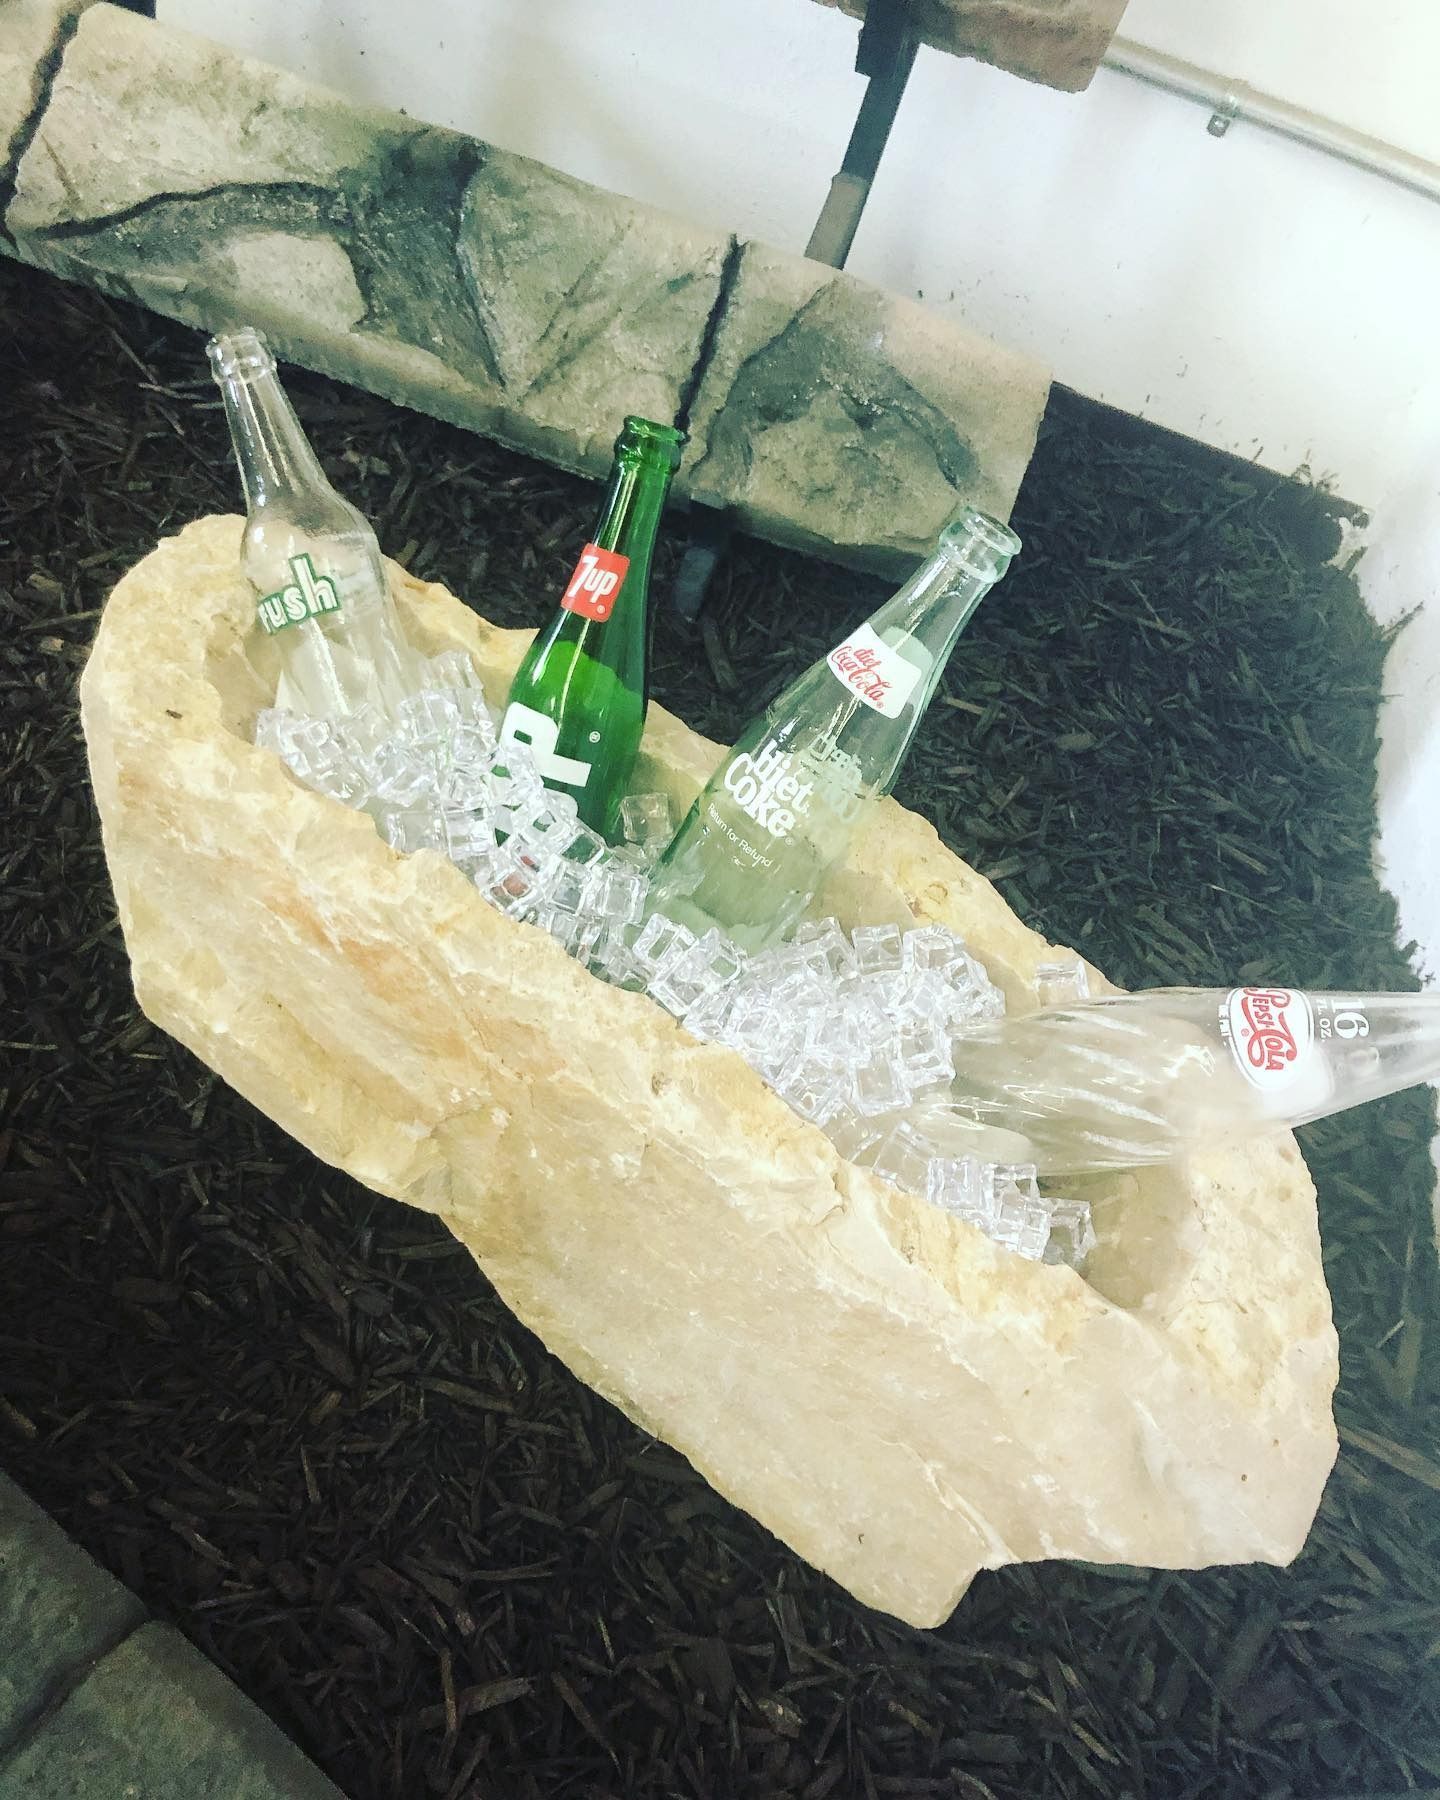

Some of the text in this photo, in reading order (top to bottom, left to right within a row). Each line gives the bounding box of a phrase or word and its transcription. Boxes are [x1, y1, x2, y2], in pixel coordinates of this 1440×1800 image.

[853, 648, 882, 669] diet
[724, 752, 797, 838] Coke
[753, 738, 814, 812] diet
[707, 803, 774, 868] Return for Refund
[1330, 998, 1370, 1040] 16
